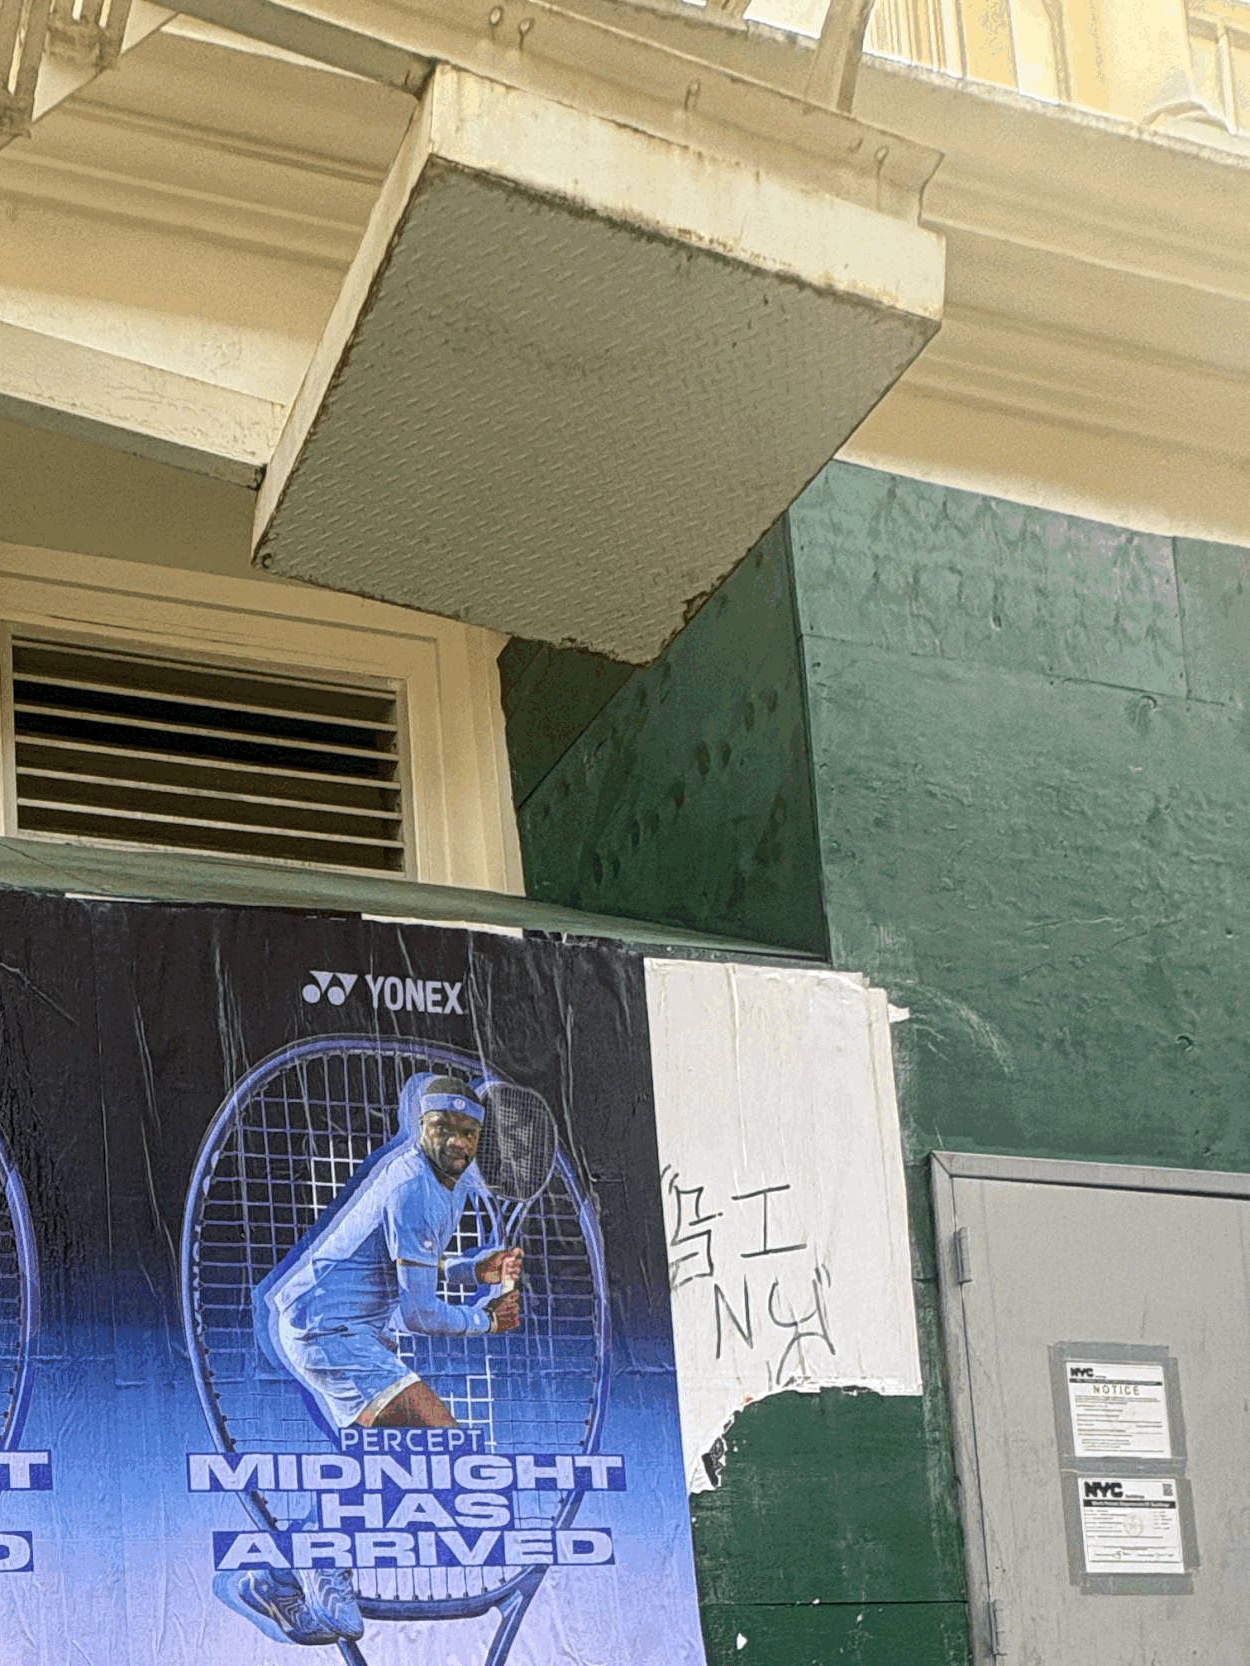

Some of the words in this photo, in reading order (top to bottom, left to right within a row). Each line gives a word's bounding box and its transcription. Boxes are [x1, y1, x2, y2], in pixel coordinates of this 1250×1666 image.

[365, 973, 464, 1015] YONEX
[1093, 1384, 1140, 1396] NOTICE
[342, 1428, 482, 1451] PERCEPT
[189, 1455, 623, 1491] MIDNIGHT
[1084, 1481, 1123, 1498] NYC
[322, 1493, 512, 1528] HAS
[218, 1531, 613, 1570] ARRIVED
